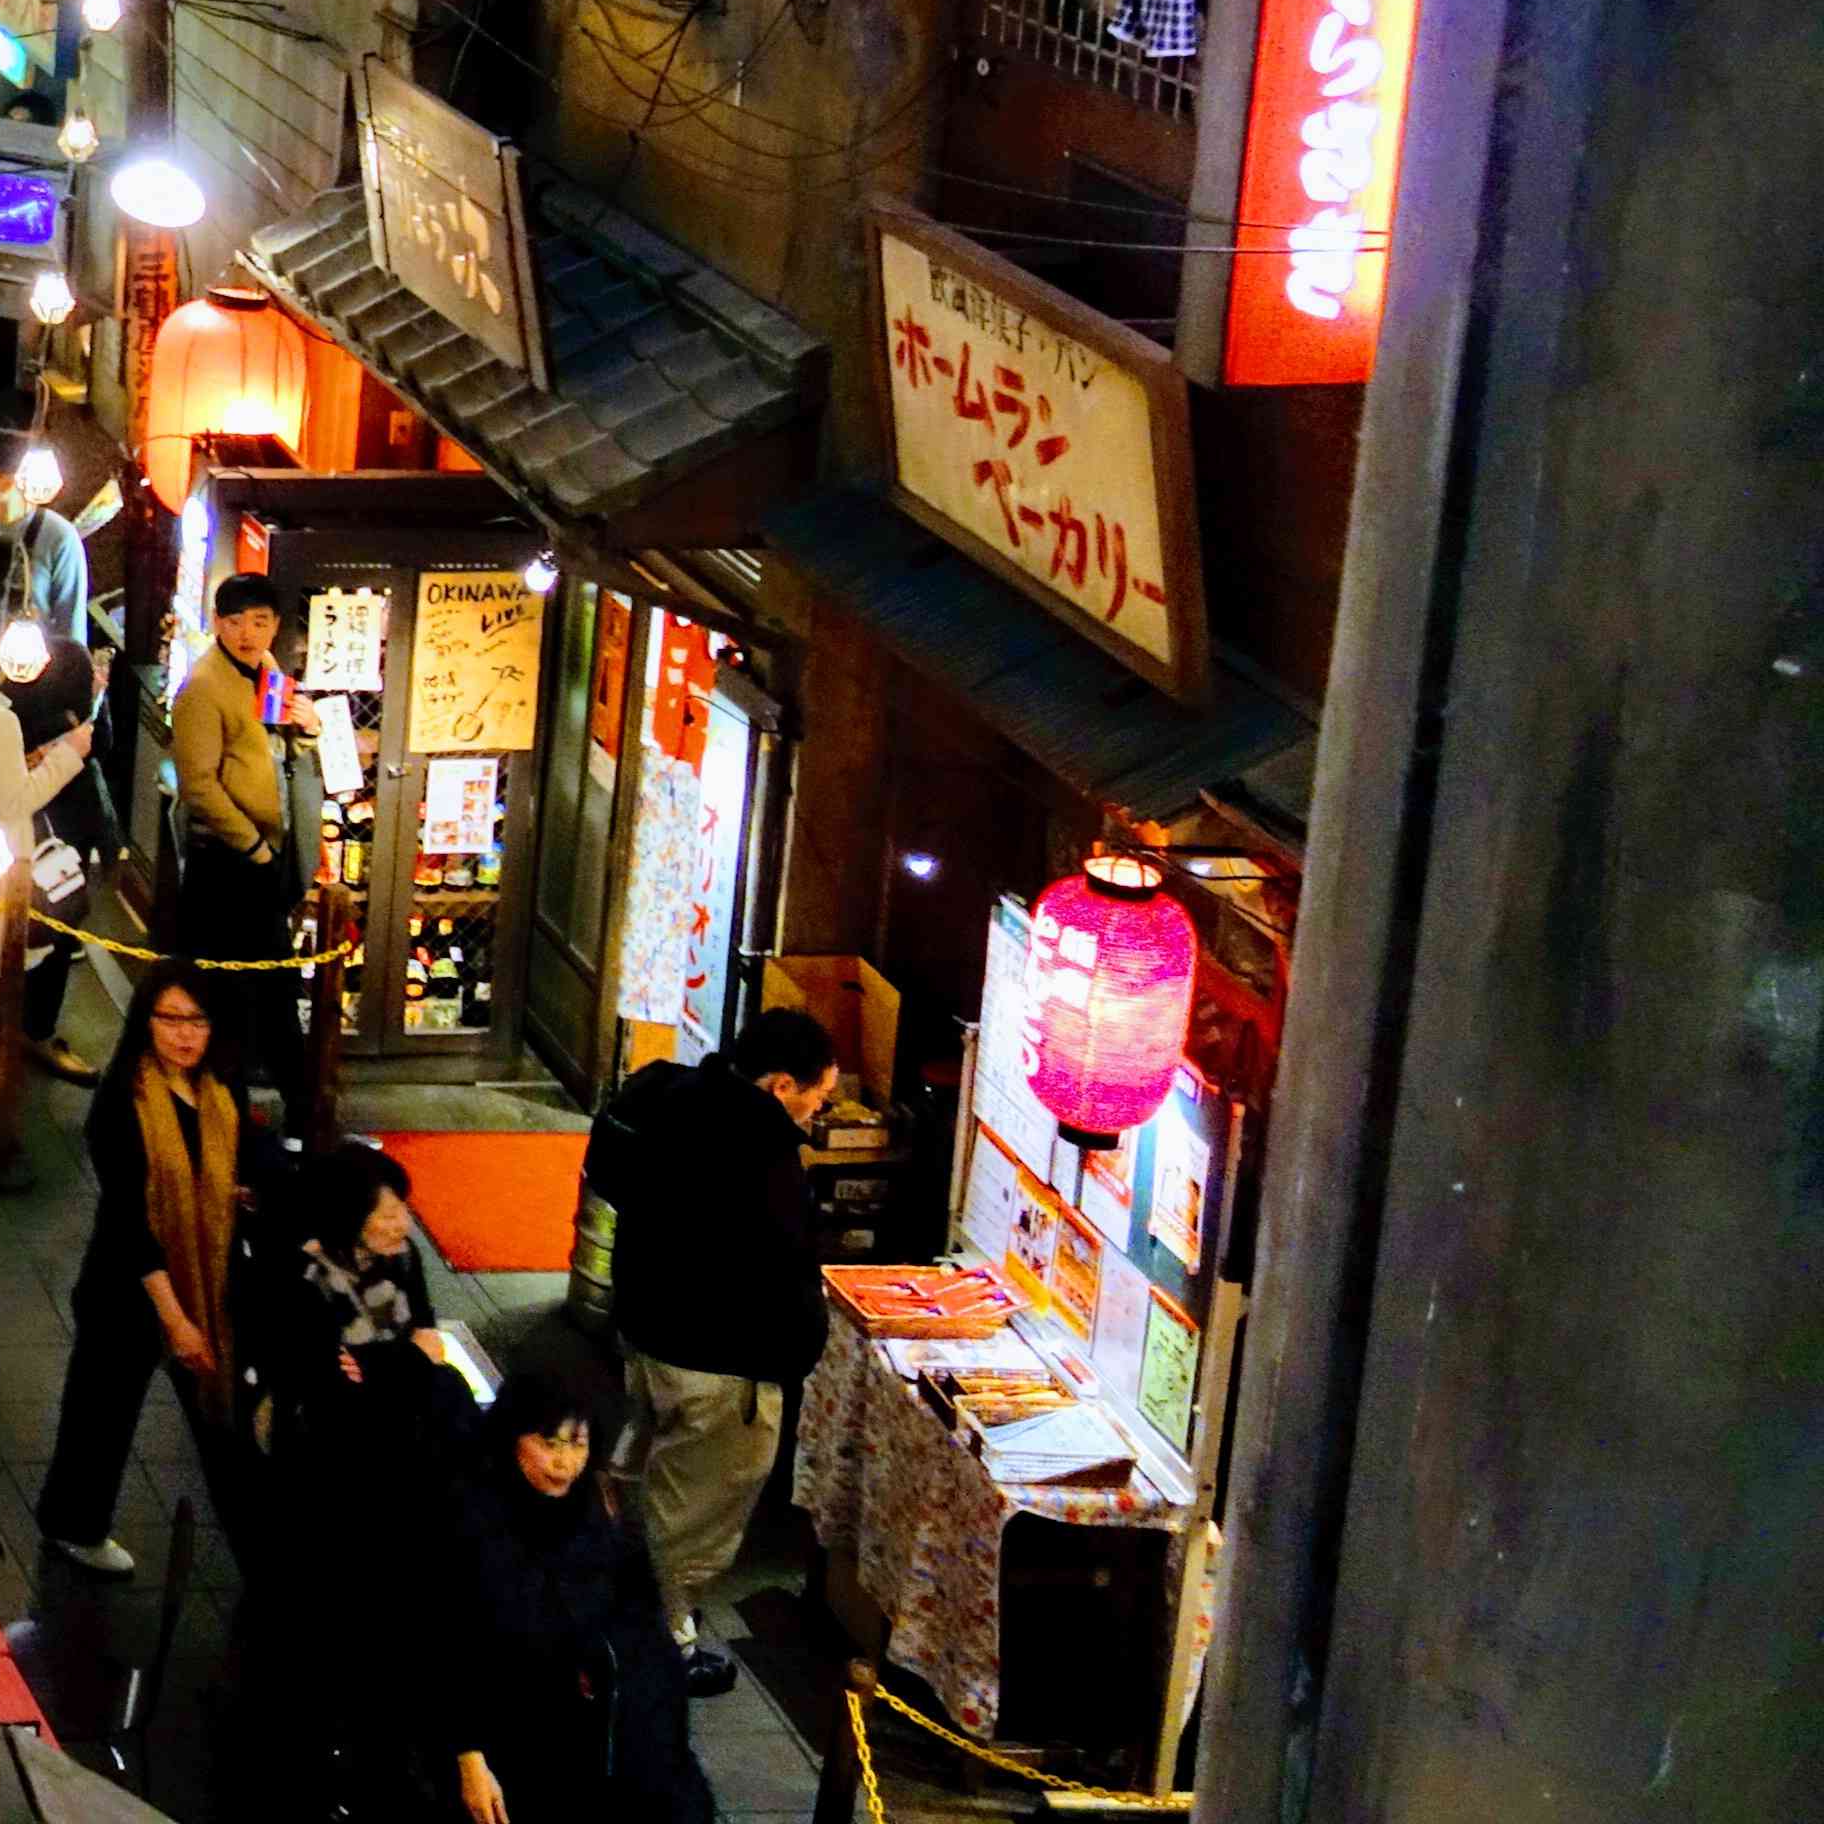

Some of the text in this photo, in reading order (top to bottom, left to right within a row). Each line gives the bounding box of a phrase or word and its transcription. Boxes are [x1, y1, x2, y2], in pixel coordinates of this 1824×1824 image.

[893, 304, 1070, 466] ホームラン
[427, 581, 532, 605] OKINAWA
[971, 460, 1168, 622] ベーカリー
